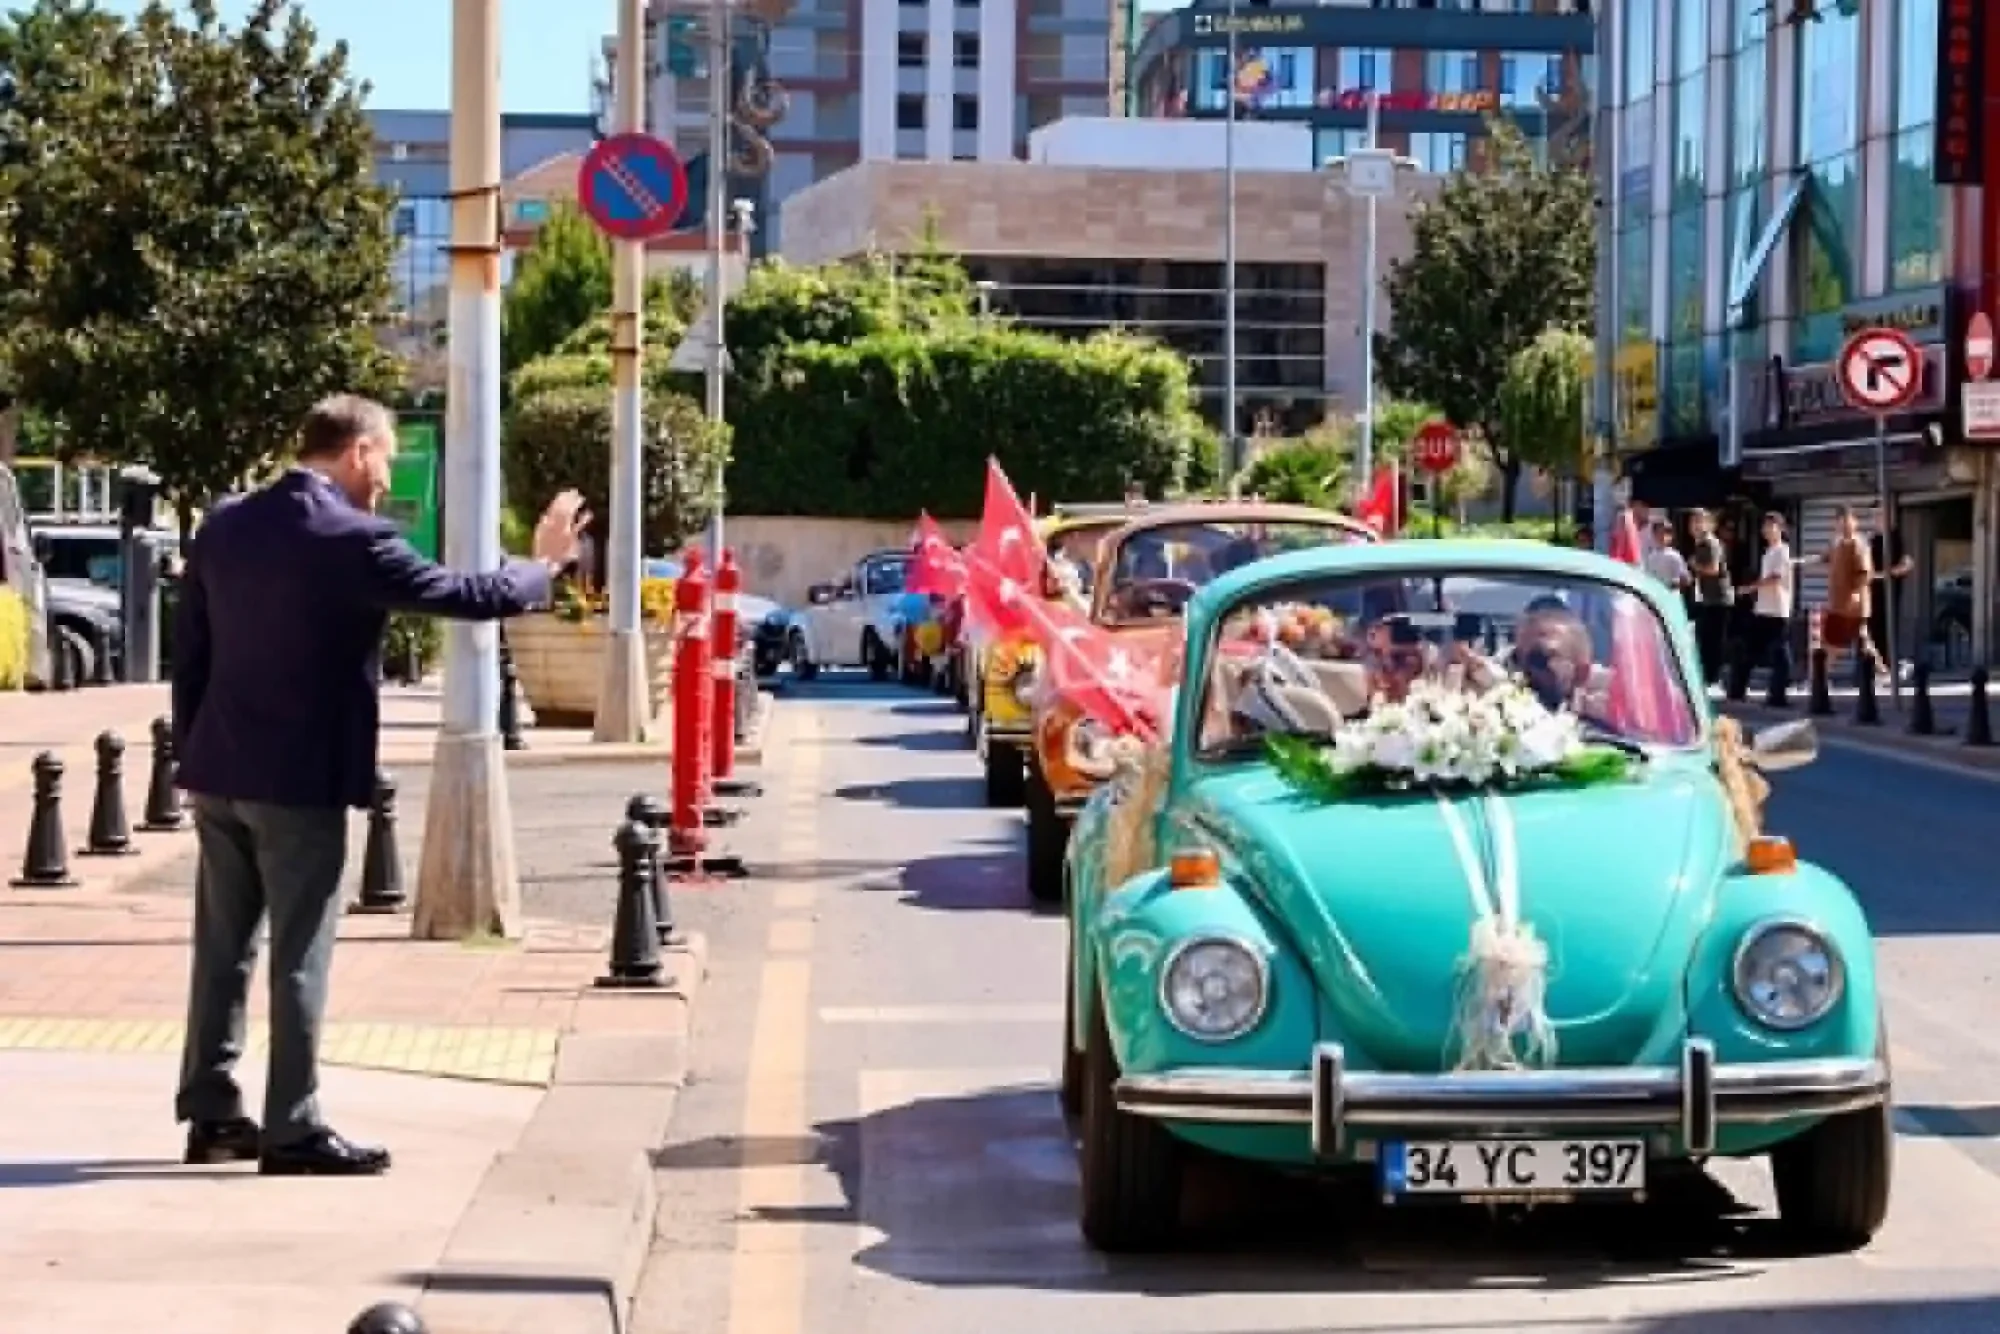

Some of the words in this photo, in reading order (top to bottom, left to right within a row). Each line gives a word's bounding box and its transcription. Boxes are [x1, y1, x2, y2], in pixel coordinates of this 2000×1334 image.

[1408, 1145, 1457, 1187] 34
[1476, 1143, 1537, 1187] YC
[1563, 1143, 1642, 1185] 397
